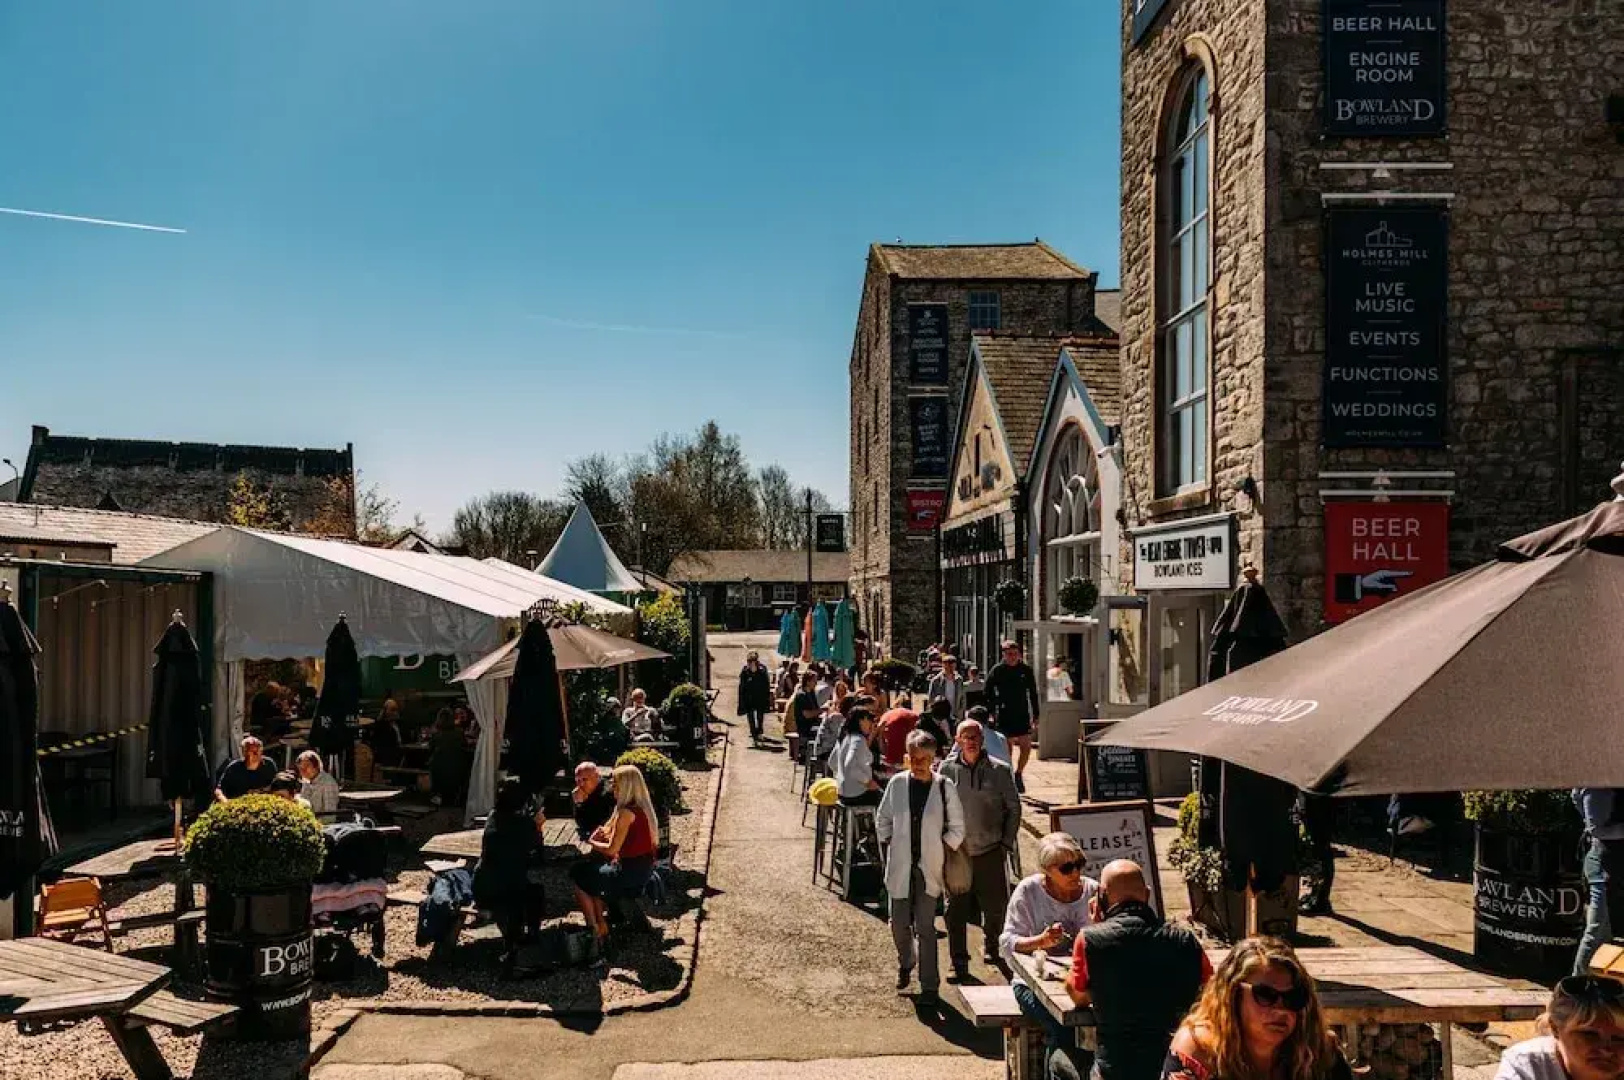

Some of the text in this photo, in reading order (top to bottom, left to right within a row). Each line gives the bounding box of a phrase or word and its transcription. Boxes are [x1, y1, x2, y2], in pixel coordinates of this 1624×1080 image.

[1332, 16, 1437, 31] BEER HALL
[1349, 51, 1420, 66] ENGINE
[1355, 68, 1414, 82] ROOM
[1335, 98, 1435, 121] BOWLAND
[1356, 114, 1409, 125] BREWERY
[1342, 249, 1429, 259] HOLMES MILL
[1365, 281, 1406, 296] LIVE
[1355, 298, 1416, 312] MUSIC
[1349, 330, 1421, 346] EVENTS
[1330, 366, 1440, 381] FUNCTIONS
[1331, 402, 1437, 417] WEDDINGS
[911, 499, 943, 507] BISTRO
[1351, 519, 1421, 537] BEER
[1352, 543, 1421, 561] HALL
[1076, 834, 1132, 851] LEASE
